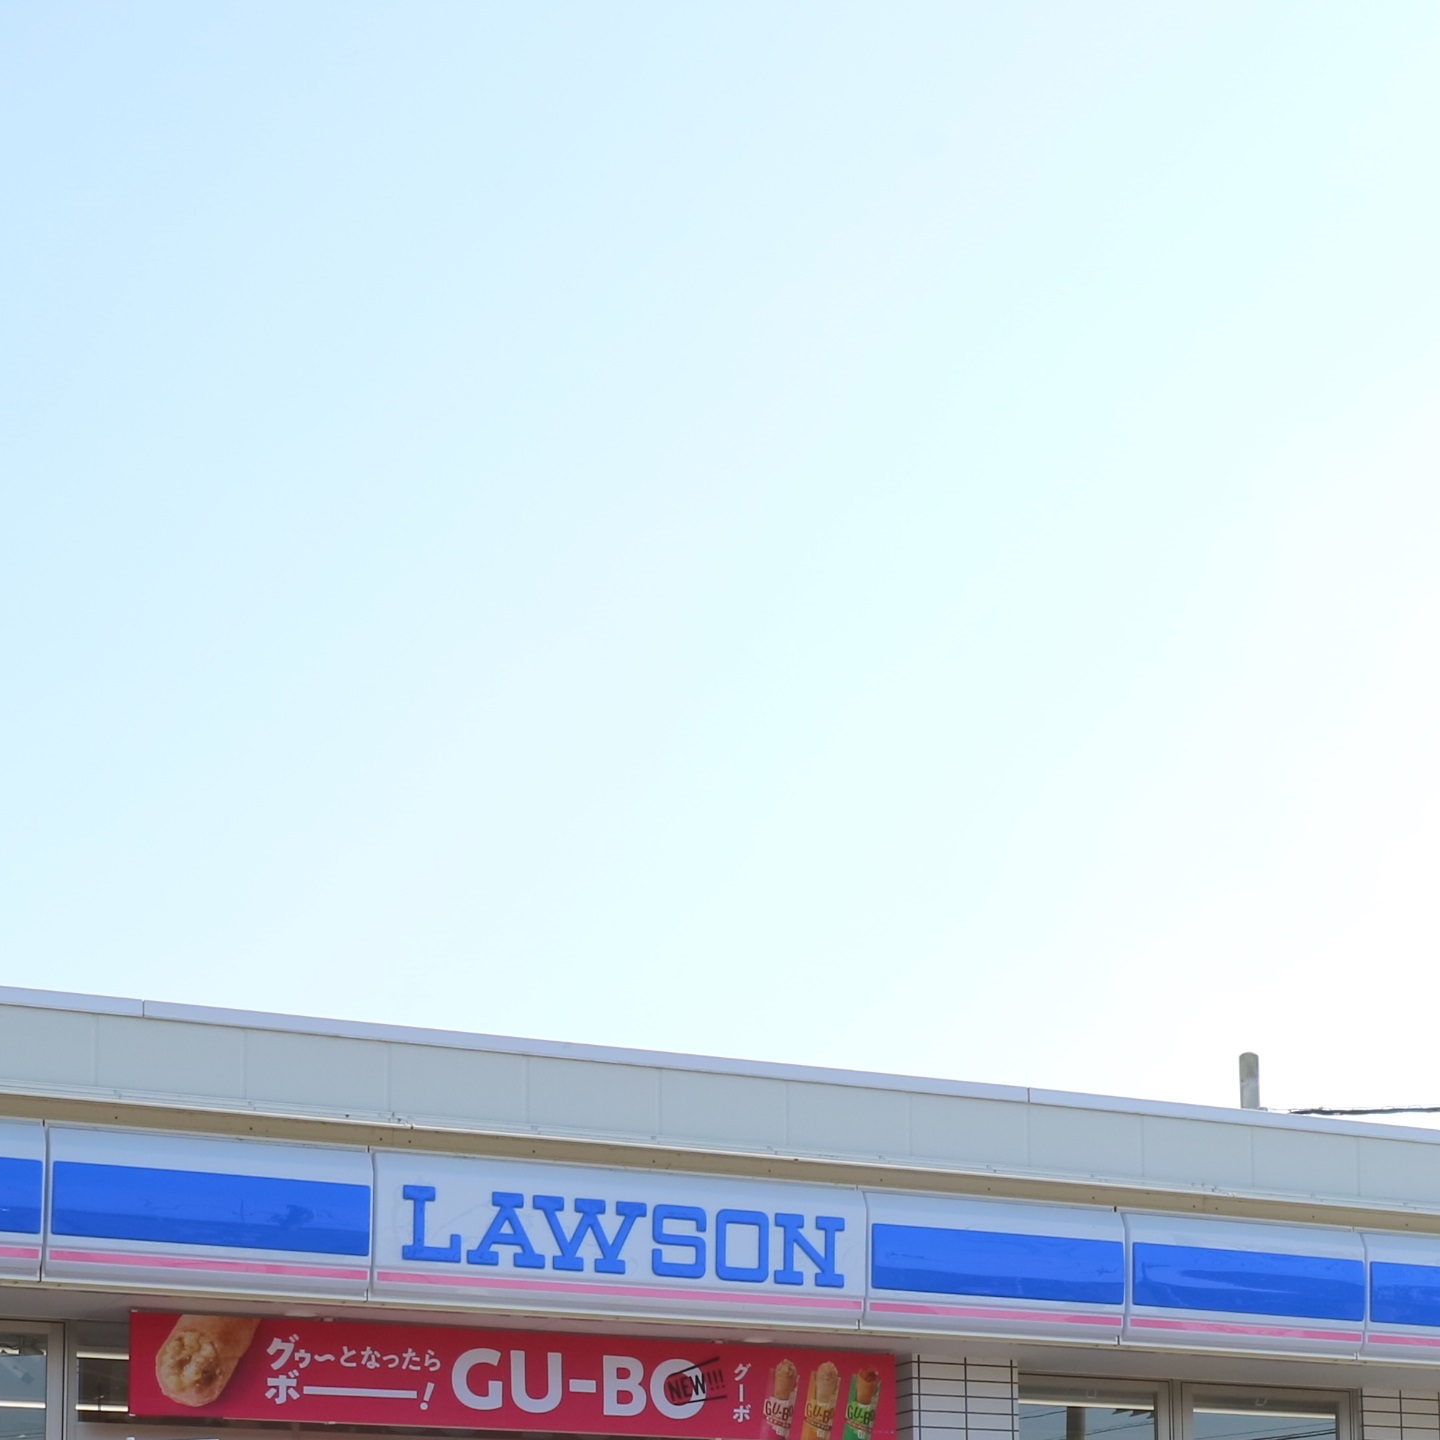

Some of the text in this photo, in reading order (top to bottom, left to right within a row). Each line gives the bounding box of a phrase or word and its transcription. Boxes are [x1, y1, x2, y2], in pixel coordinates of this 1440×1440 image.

[402, 1184, 846, 1288] LAWSON
[451, 1347, 707, 1420] GU-BO
[667, 1369, 726, 1402] NEW!!!
[732, 1362, 752, 1423] グーボ
